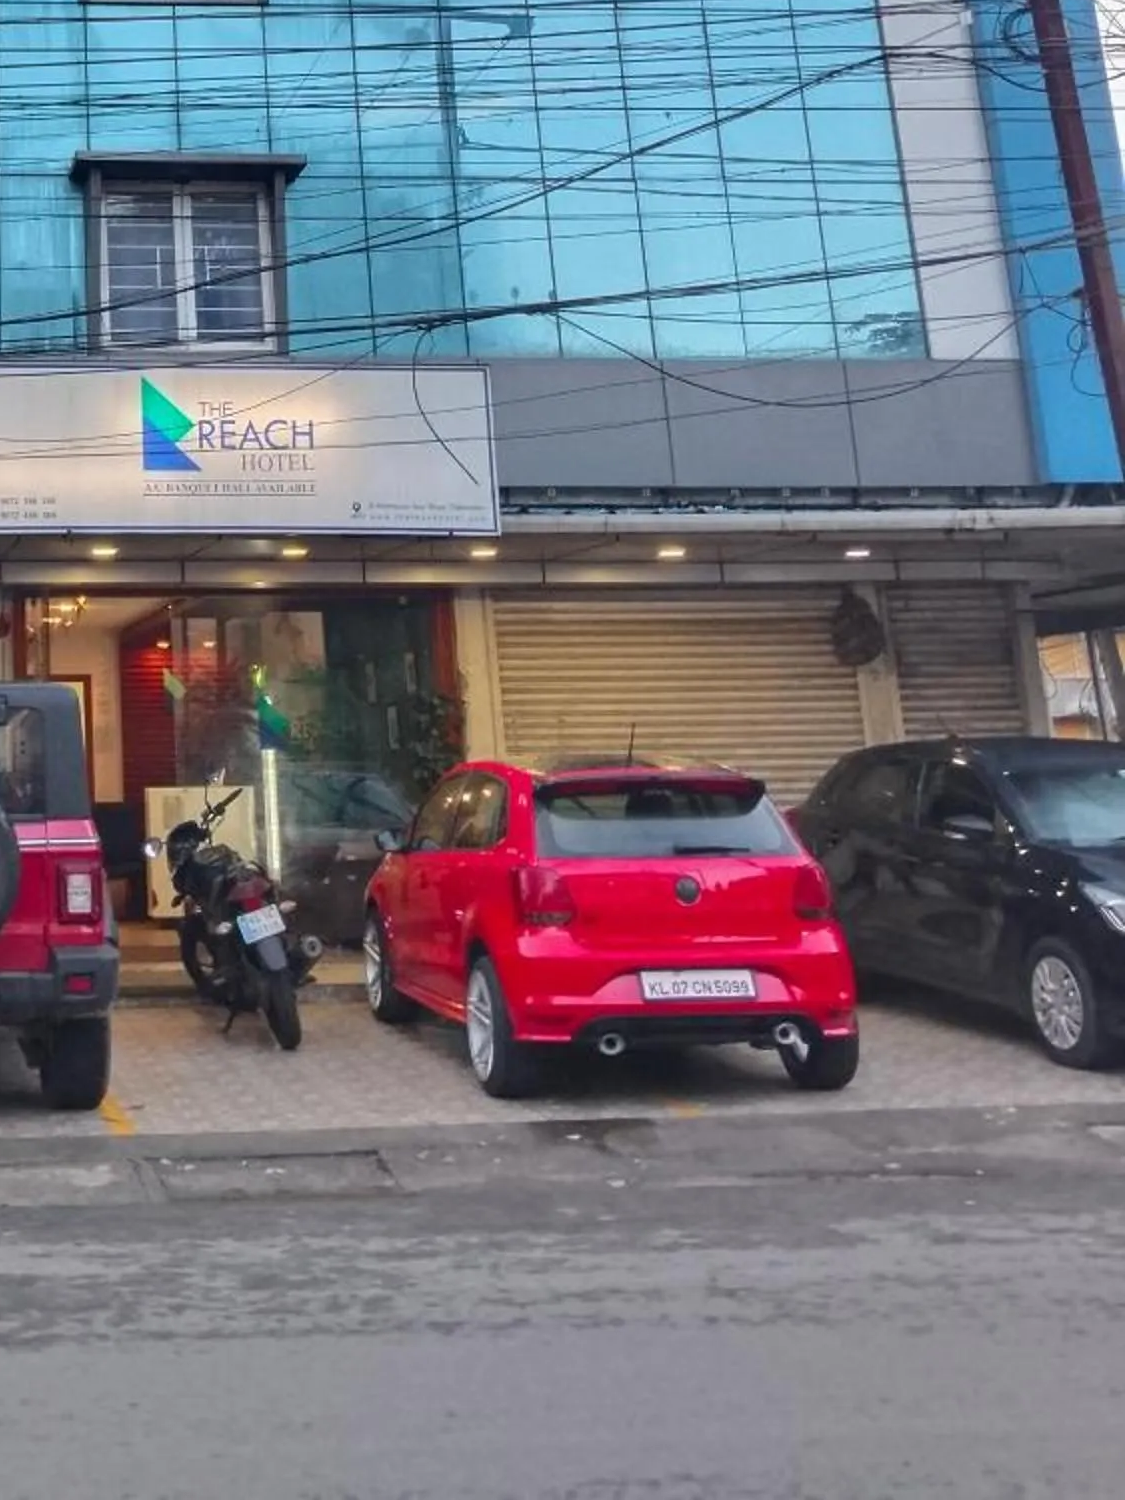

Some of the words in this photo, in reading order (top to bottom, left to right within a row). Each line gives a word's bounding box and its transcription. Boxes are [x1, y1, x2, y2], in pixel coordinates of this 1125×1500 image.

[197, 401, 234, 418] THE
[198, 419, 314, 450] REACH
[241, 453, 316, 472] HOTEL
